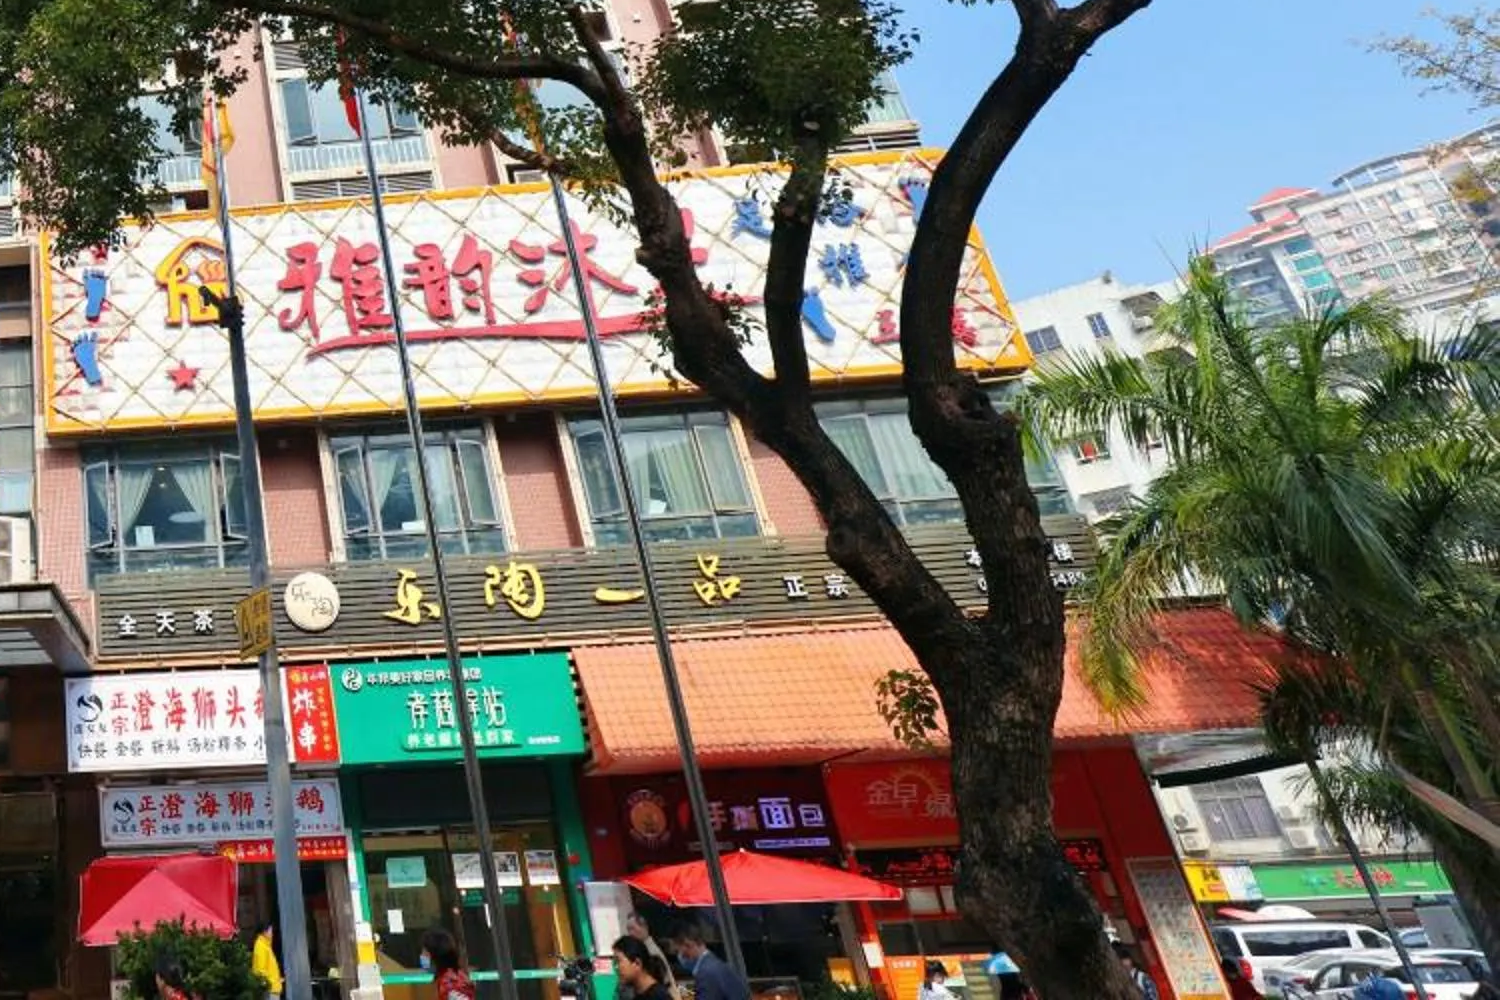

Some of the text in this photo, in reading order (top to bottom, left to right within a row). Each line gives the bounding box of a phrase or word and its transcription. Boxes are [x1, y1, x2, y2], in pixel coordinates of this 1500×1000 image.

[782, 574, 850, 601] 正宗
[118, 607, 242, 638] 全天茶
[292, 688, 317, 755] 炸串
[160, 786, 325, 819] 澄海狮鹅
